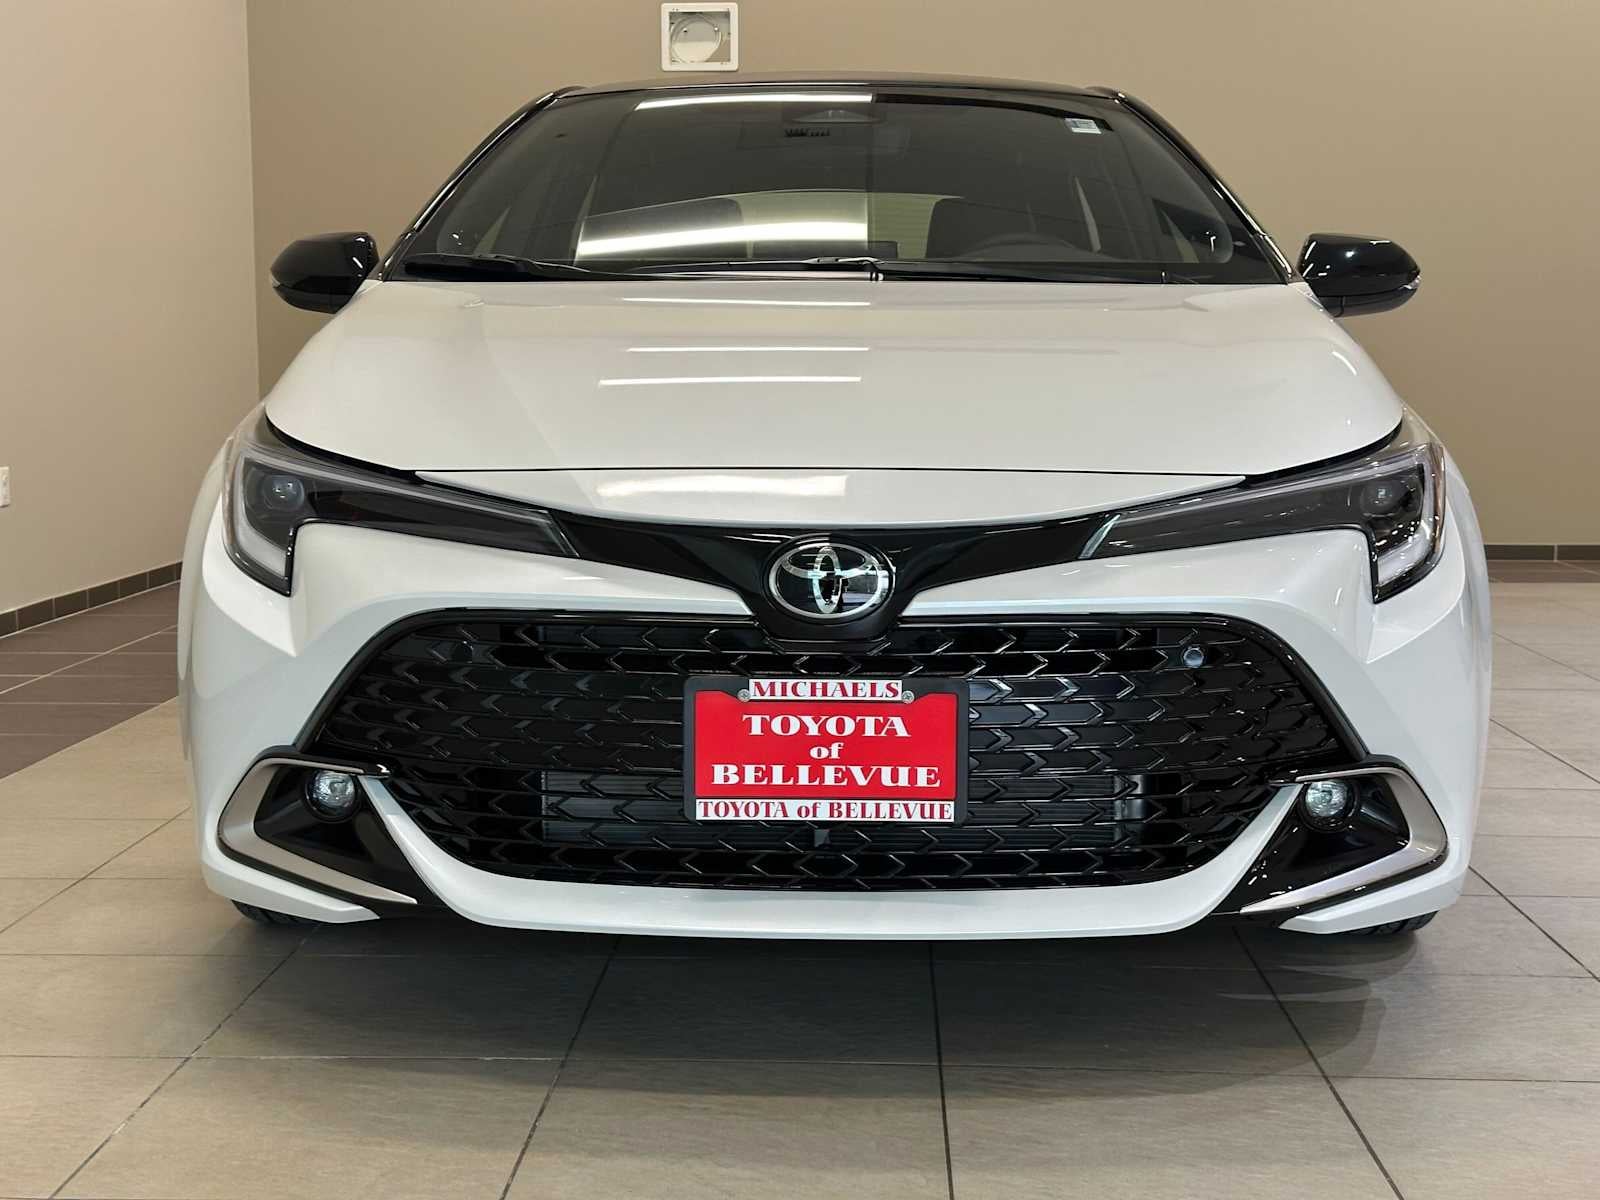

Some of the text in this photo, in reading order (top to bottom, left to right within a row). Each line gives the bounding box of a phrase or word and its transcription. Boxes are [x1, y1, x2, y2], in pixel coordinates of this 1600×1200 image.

[753, 680, 899, 699] MICHAELS
[742, 714, 911, 737] TOYOTA
[809, 742, 844, 760] of
[711, 763, 941, 788] BELLEVUE
[698, 800, 953, 820] TOYOTA of BELLEVUE
